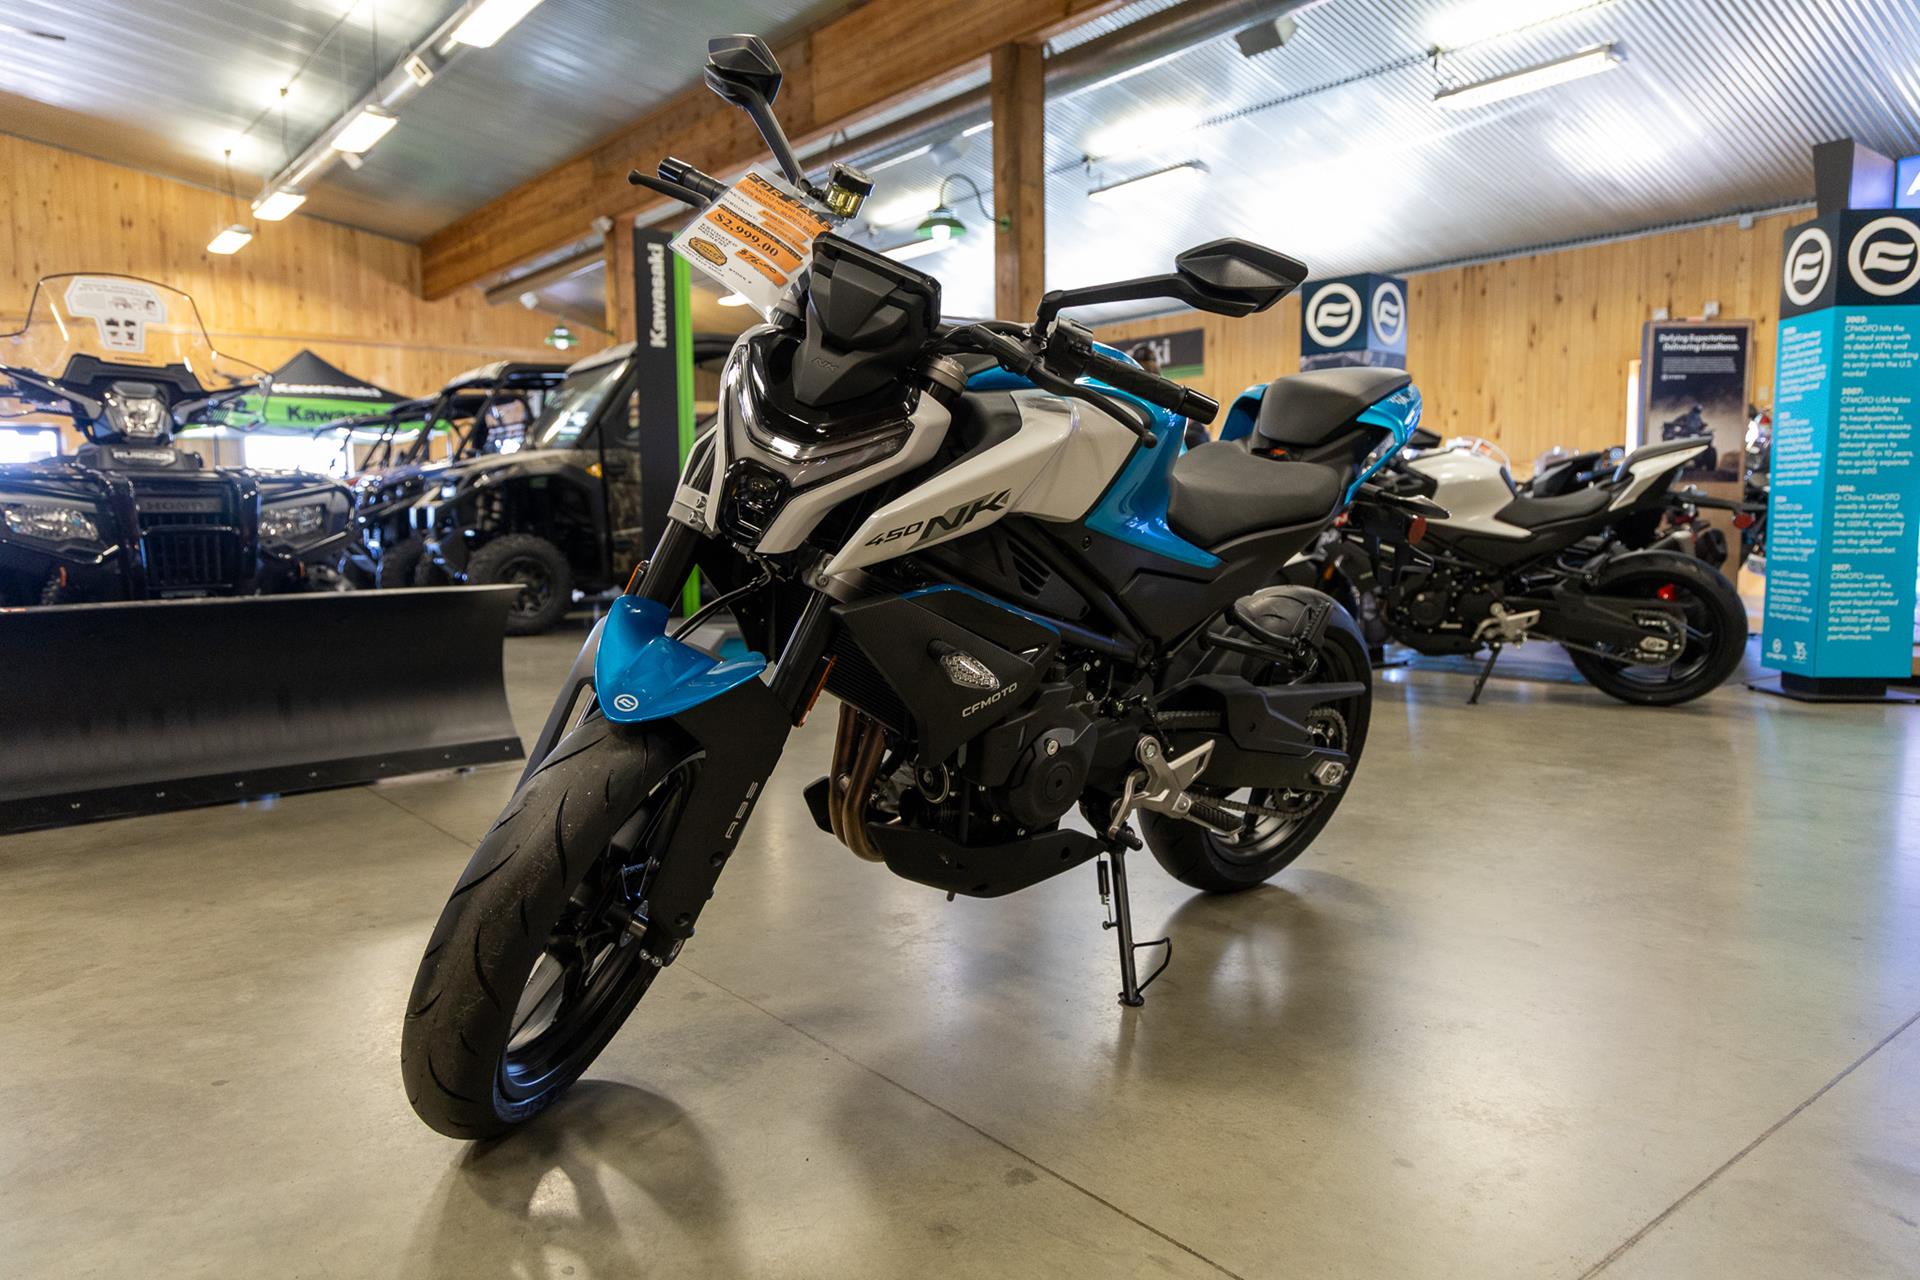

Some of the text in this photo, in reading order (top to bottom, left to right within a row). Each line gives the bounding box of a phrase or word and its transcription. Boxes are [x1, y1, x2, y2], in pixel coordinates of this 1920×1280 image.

[714, 213, 779, 257] $2,999.00
[647, 242, 667, 348] Kawasaki
[1659, 333, 1738, 344] Defying Expectations.
[1662, 342, 1740, 353] Delivering Excellence.
[112, 450, 175, 461] RUBICON
[865, 488, 1011, 546] 450 NK
[962, 682, 1018, 718] CFMOTO
[725, 781, 759, 839] ABS
